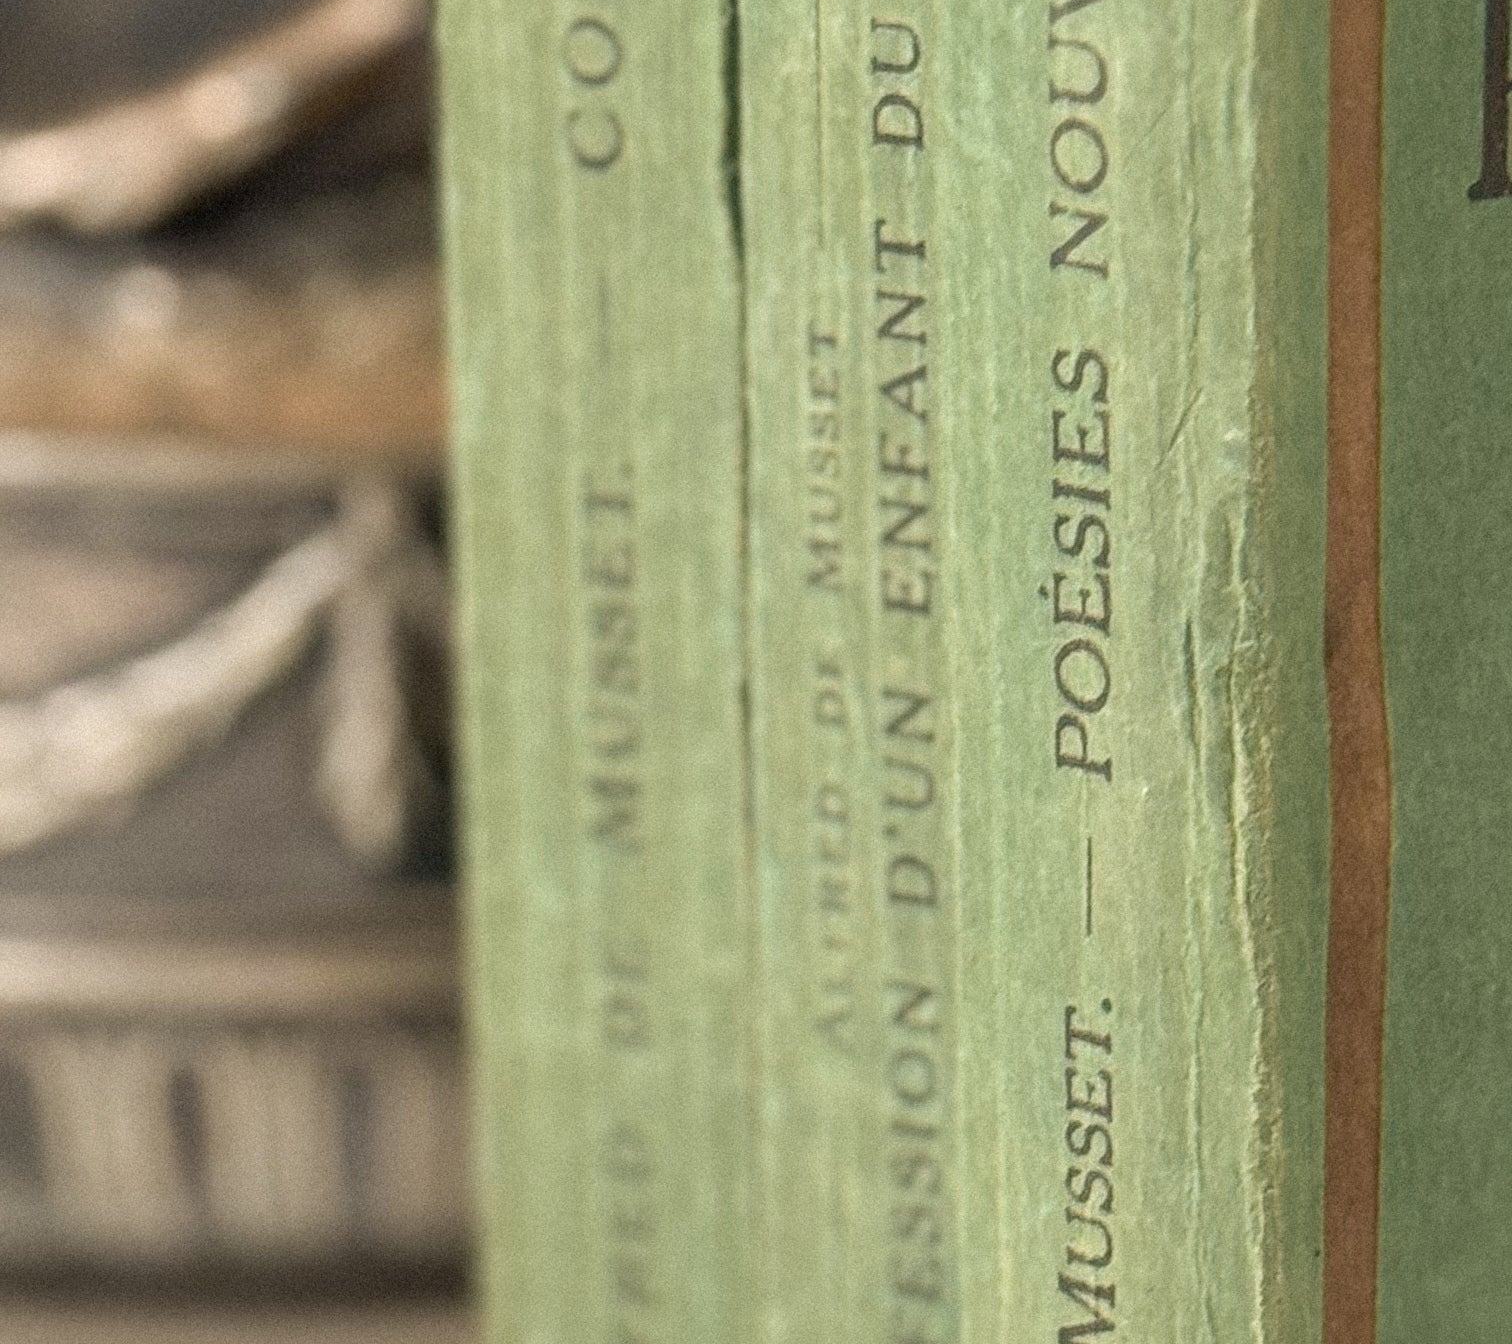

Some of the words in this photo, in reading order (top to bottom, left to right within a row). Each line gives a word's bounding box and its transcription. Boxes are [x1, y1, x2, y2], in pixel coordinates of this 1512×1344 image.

[870, 17, 925, 152] DU
[806, 317, 840, 592] MUSSET
[874, 219, 932, 618] ENFANT
[1039, 348, 1113, 783] POÉSIES
[881, 686, 940, 911] D'UN
